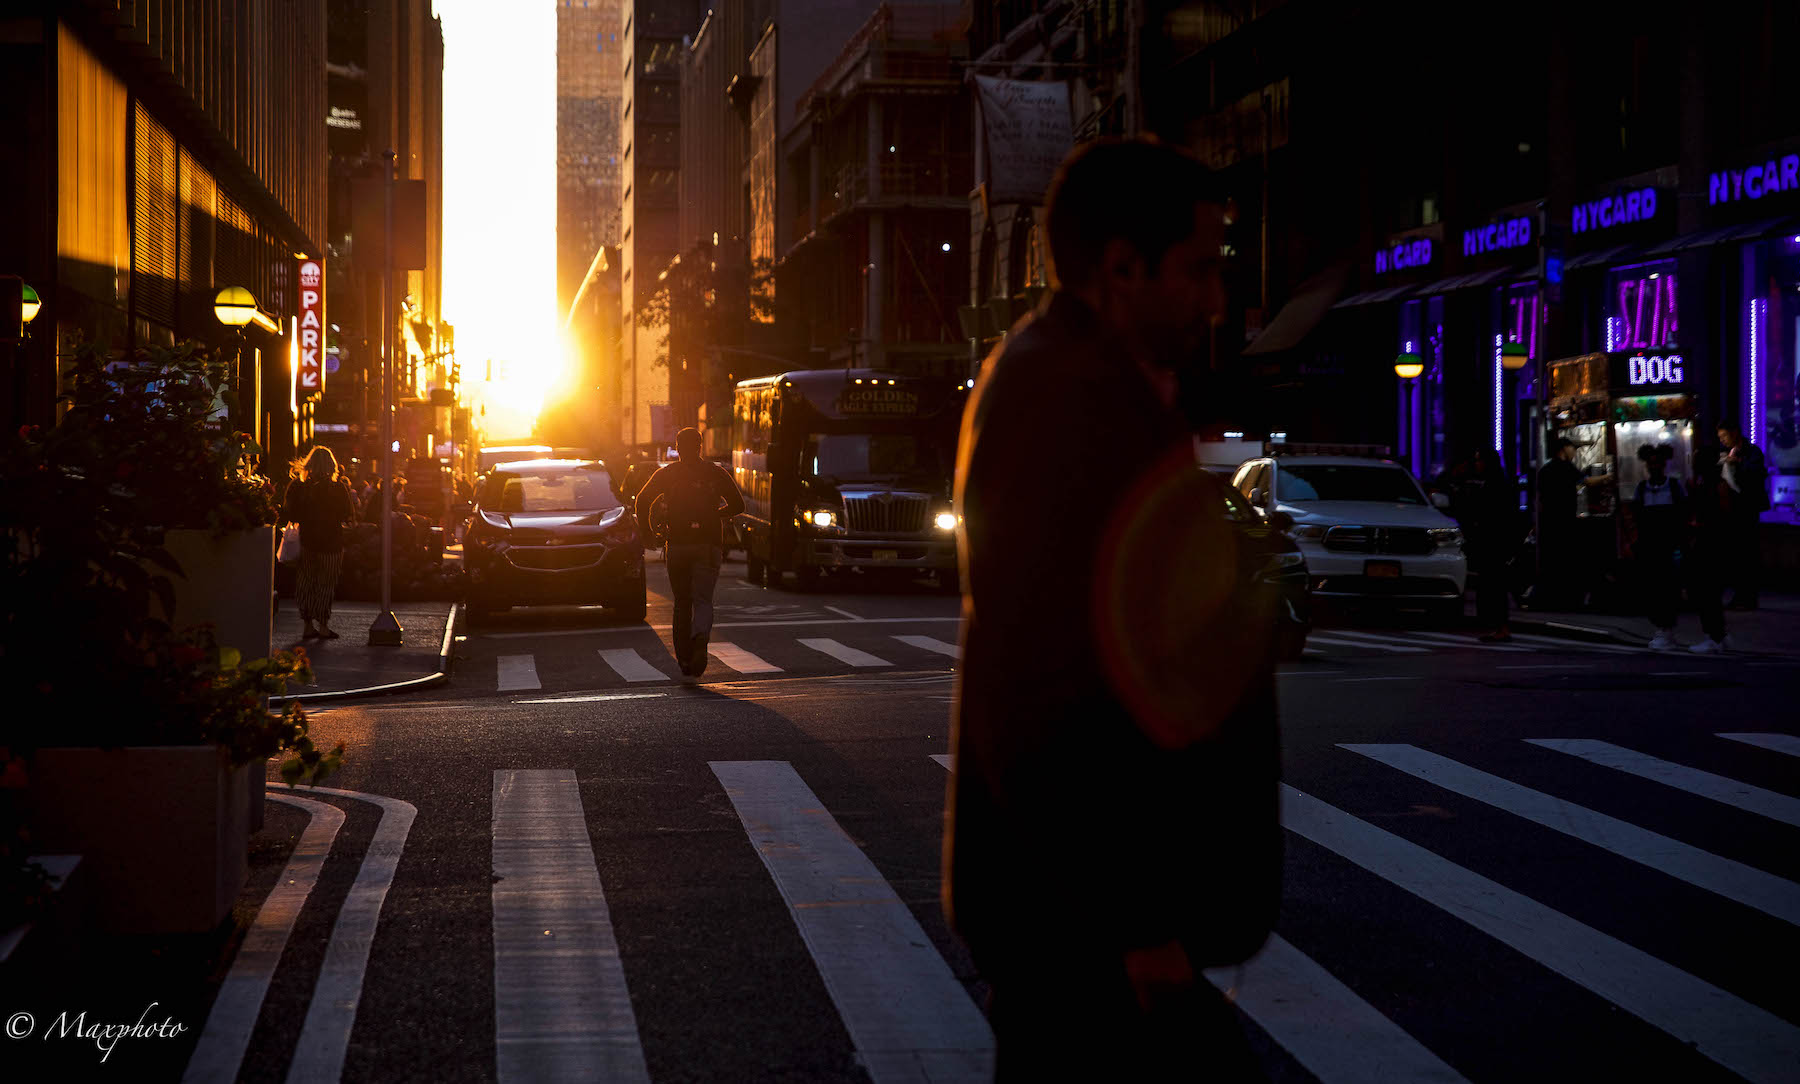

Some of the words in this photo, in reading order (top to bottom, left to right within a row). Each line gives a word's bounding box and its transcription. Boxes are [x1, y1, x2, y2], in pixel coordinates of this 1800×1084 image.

[302, 290, 320, 367] PARK
[1628, 354, 1684, 386] DOG
[849, 391, 918, 402] GOLDEN
